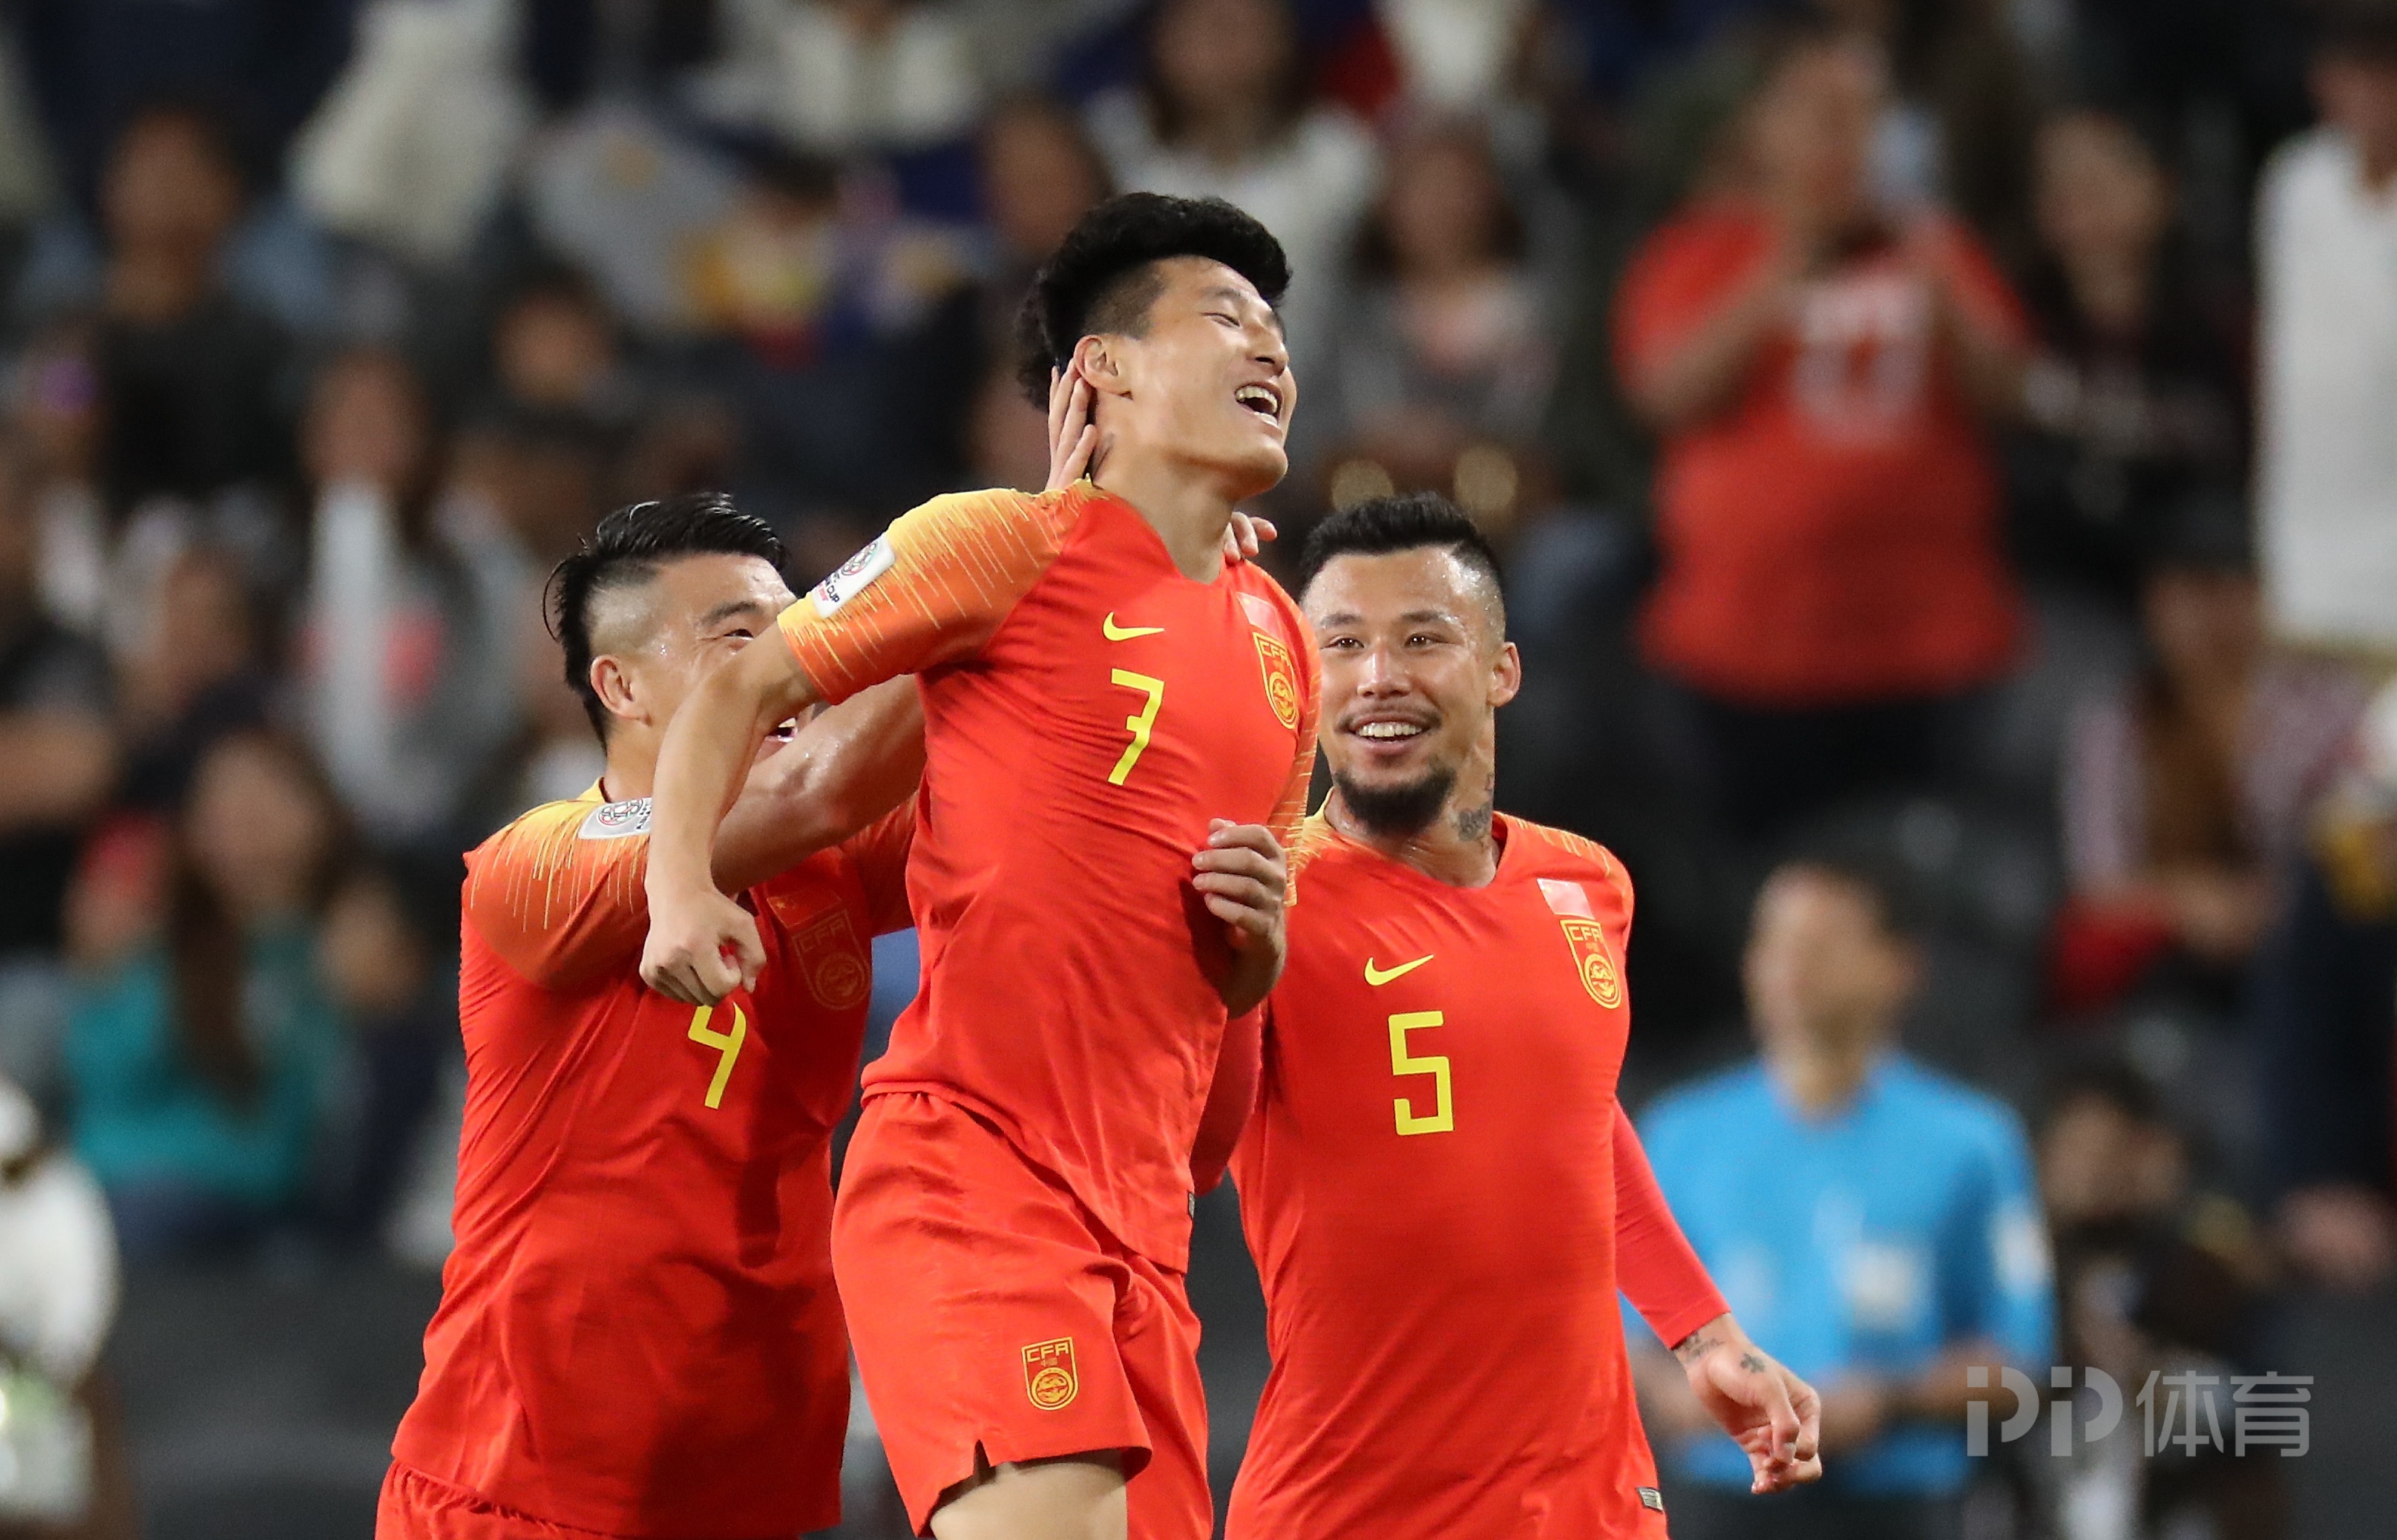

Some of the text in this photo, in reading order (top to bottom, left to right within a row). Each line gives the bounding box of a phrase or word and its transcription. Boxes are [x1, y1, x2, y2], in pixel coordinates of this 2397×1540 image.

[1259, 639, 1290, 666] CFA
[1108, 668, 1165, 786] 7
[1567, 925, 1604, 943] CFA
[1388, 1010, 1455, 1136] 5
[1026, 1342, 1069, 1363] CFA
